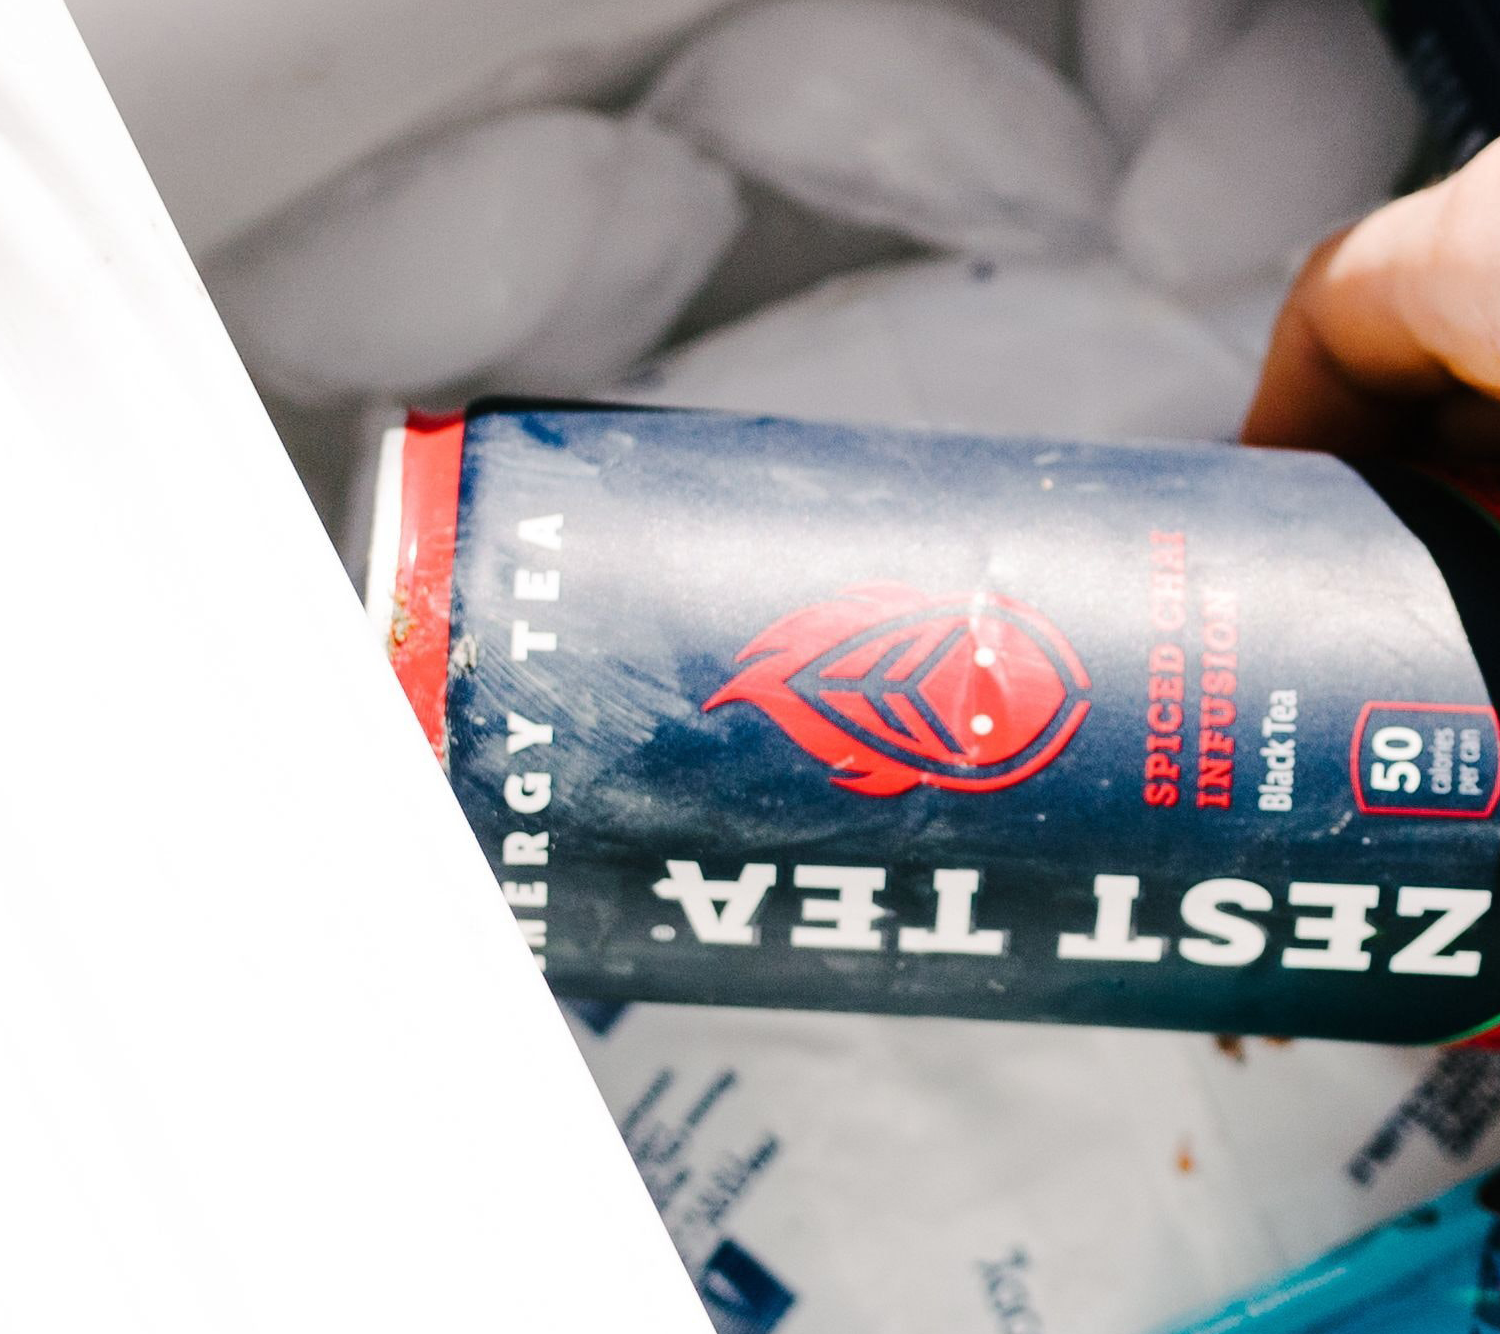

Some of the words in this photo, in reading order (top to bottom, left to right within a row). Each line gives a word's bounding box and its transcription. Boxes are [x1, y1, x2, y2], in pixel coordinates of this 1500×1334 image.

[510, 512, 564, 661] TEA
[1149, 530, 1187, 631] CHAI
[1143, 642, 1186, 807] SPICED
[1197, 591, 1241, 810] INFUSION
[1261, 689, 1298, 735] Tea
[1459, 728, 1481, 763] can
[1258, 737, 1296, 811] Black
[1370, 726, 1423, 794] 50
[1430, 726, 1455, 795] calories
[1457, 764, 1483, 796] per
[503, 711, 553, 972] NERGY
[652, 859, 1010, 956] TEA
[1058, 875, 1493, 978] ZEST
